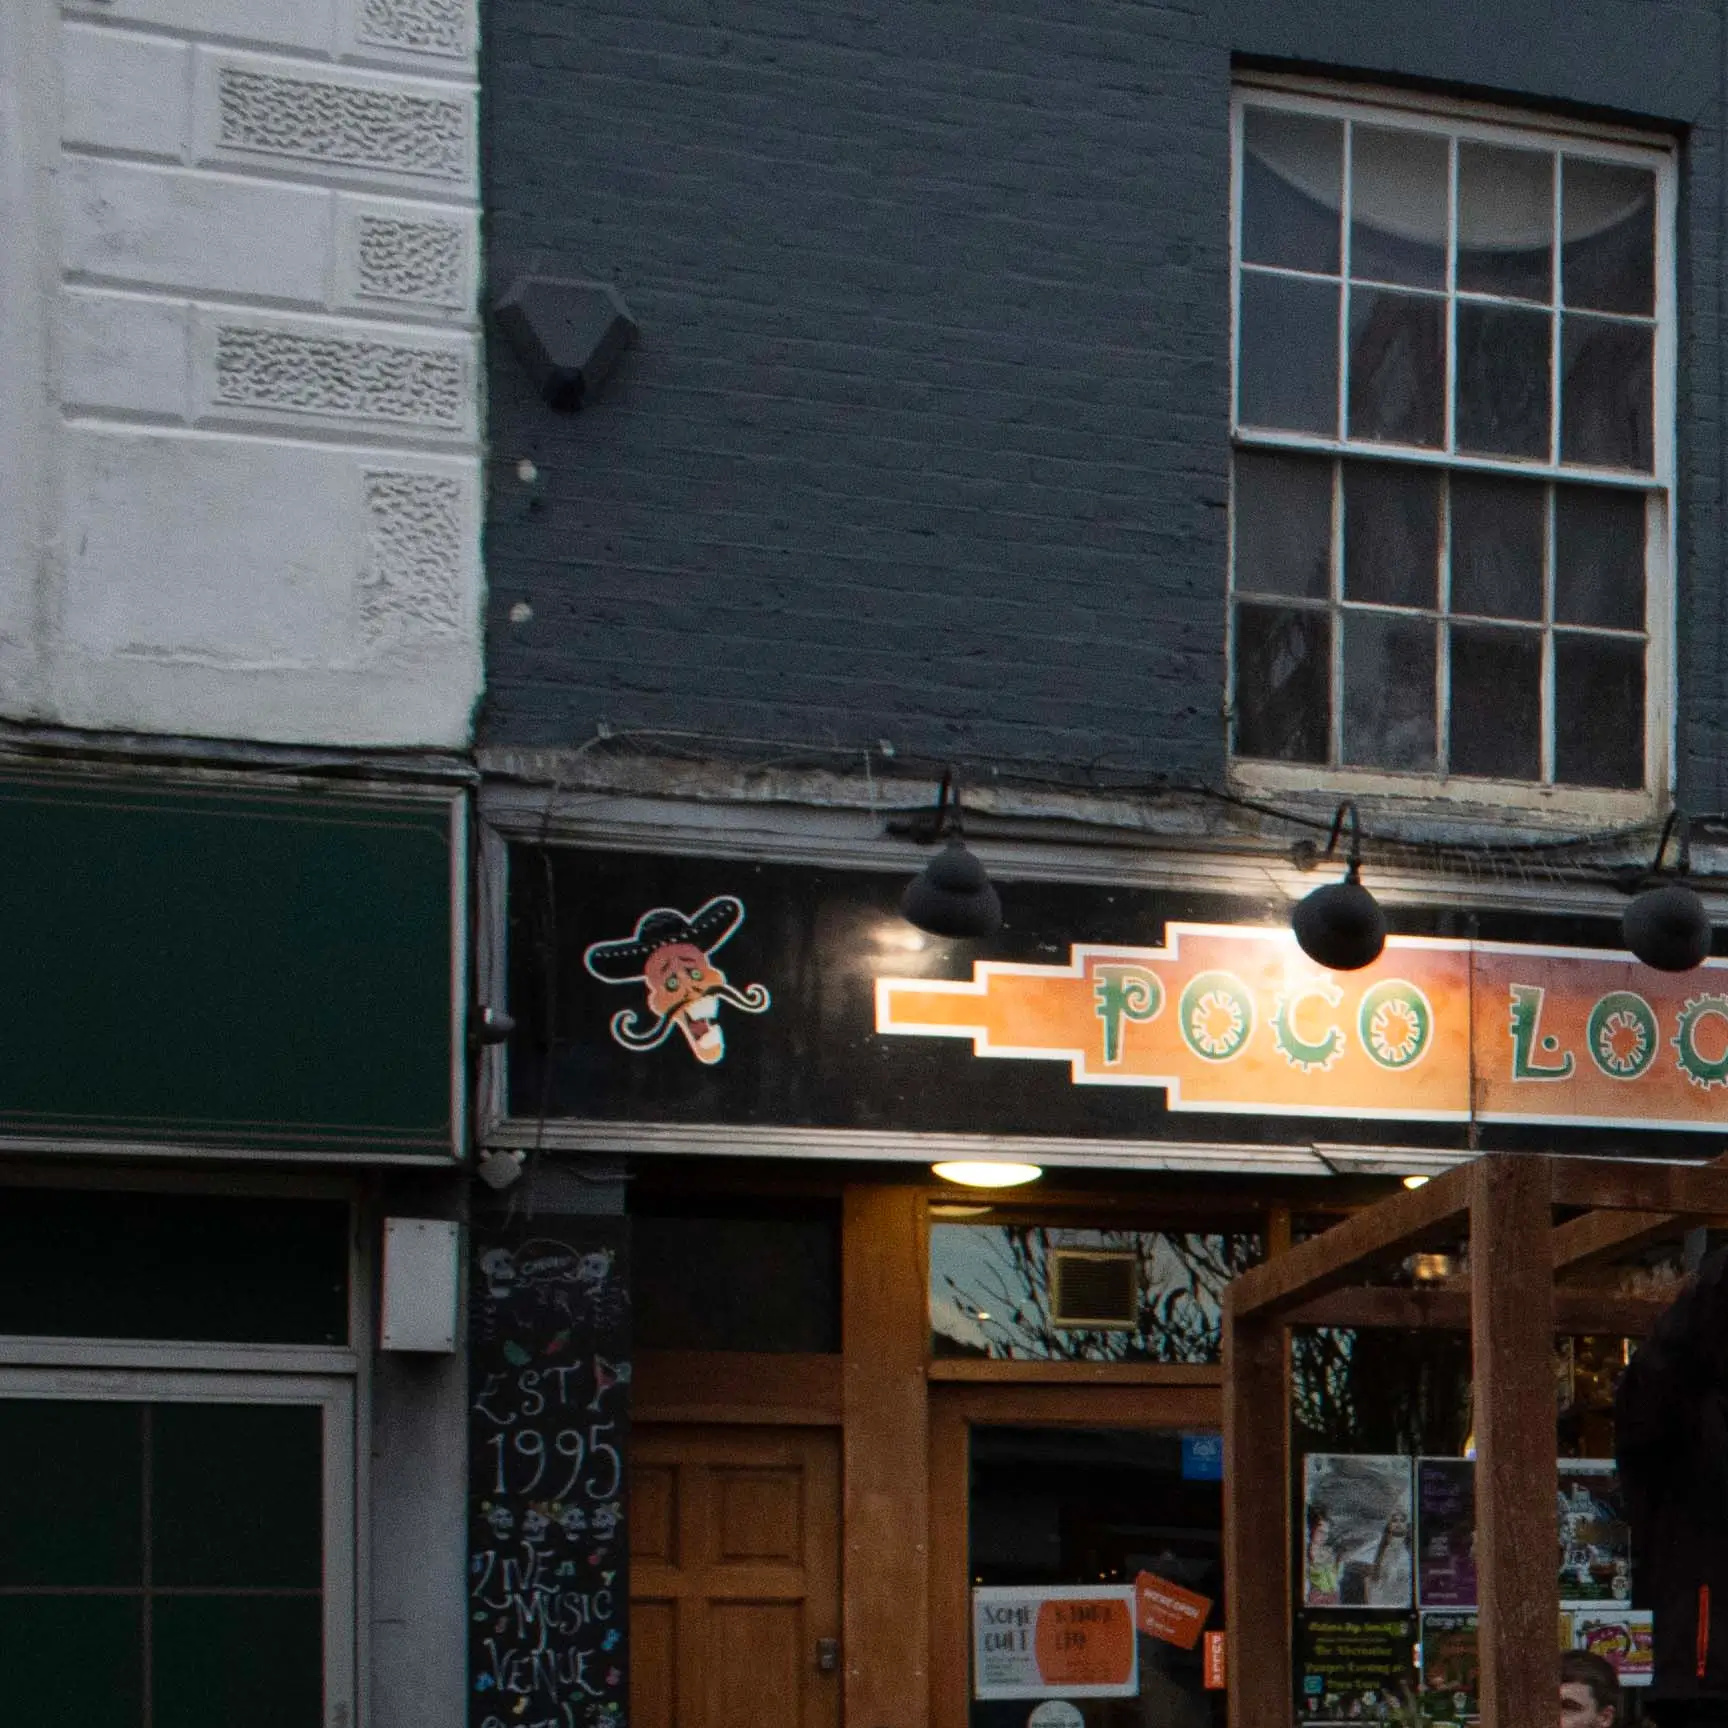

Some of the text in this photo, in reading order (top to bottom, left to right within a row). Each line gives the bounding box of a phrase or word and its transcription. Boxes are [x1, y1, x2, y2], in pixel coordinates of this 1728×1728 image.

[1093, 963, 1435, 1073] POCO
[472, 1359, 584, 1425] EST
[486, 1420, 623, 1501] 1995
[512, 1588, 614, 1650] MUSIC
[483, 1638, 605, 1704] VENUE
